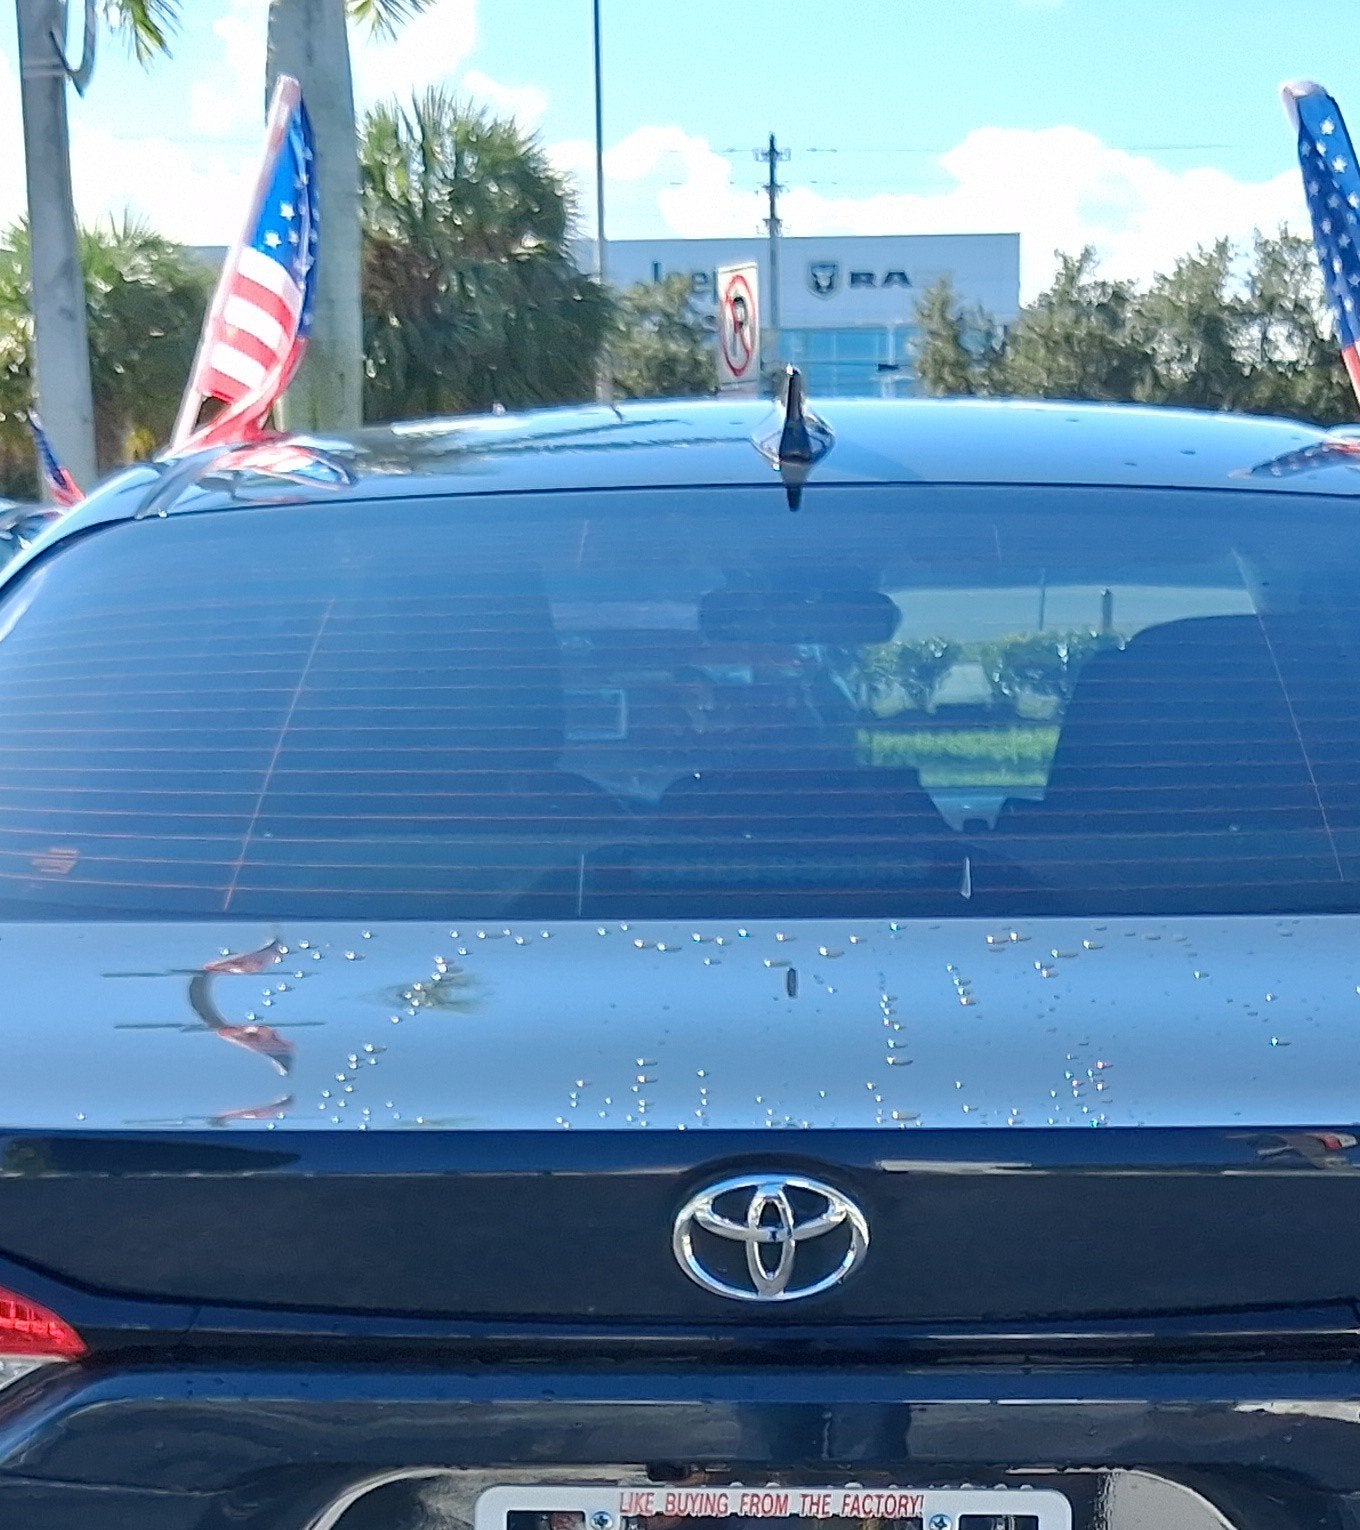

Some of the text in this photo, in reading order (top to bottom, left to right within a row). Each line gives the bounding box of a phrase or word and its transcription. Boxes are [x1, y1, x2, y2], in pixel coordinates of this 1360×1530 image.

[619, 1492, 925, 1517] LIKE BUYING FROM THE FACTORY!
